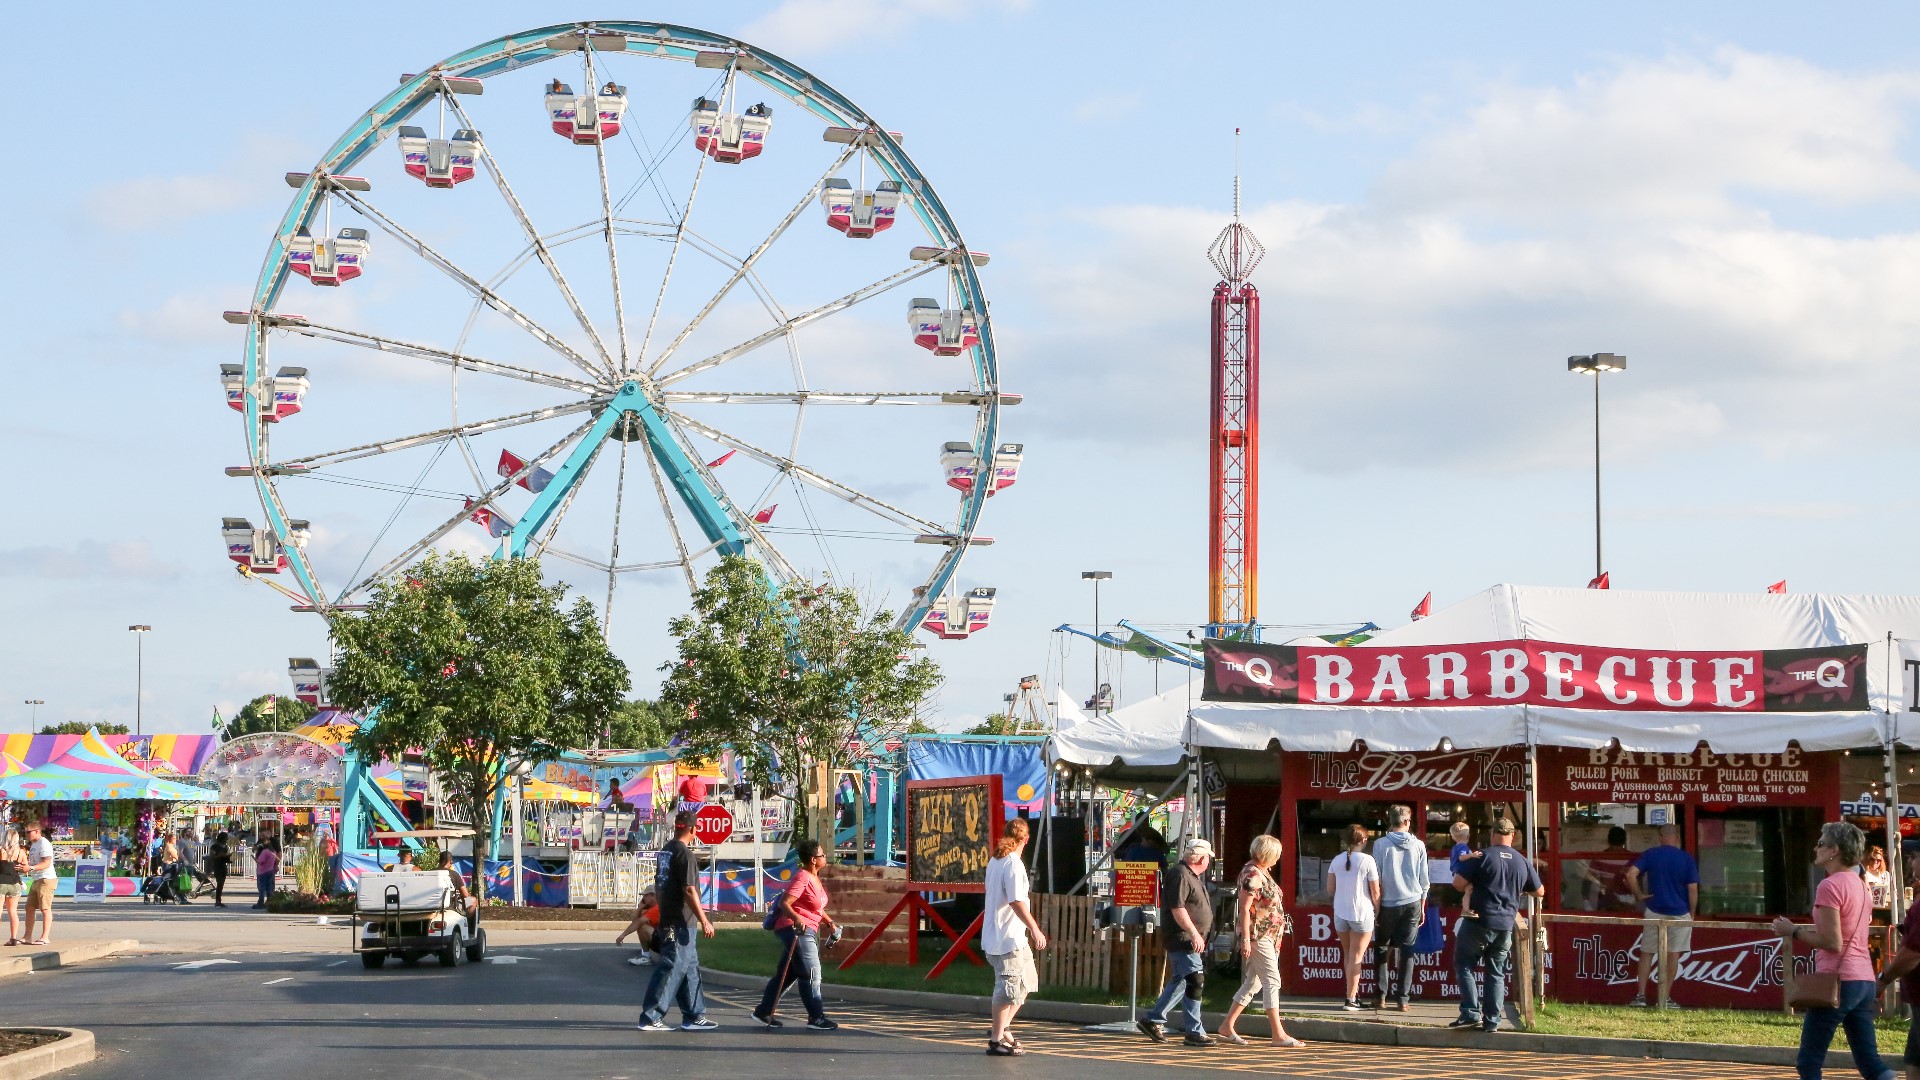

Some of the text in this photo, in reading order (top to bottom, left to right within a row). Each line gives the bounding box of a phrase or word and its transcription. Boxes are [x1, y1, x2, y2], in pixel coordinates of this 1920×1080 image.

[883, 181, 893, 189] 10
[975, 588, 988, 596] 13
[1225, 648, 1849, 708] THE Q BARBECUE THE Q
[1309, 750, 1528, 791] The Bud Ten
[1566, 765, 1809, 784] PULLED PORK BRISKET PULLED CHICKEN
[1570, 781, 1806, 795] SMOKED MUSHROOMS SLAW CORN ON THE COB
[1611, 791, 1767, 804] POTATO SALAD BAKED BEANS
[920, 793, 953, 834] THE
[1840, 803, 1919, 818] RENA
[696, 817, 731, 833] STOP
[1299, 945, 1342, 966] PULLED
[1572, 934, 1630, 980] The
[1302, 967, 1449, 982] SMOKED SLAW
